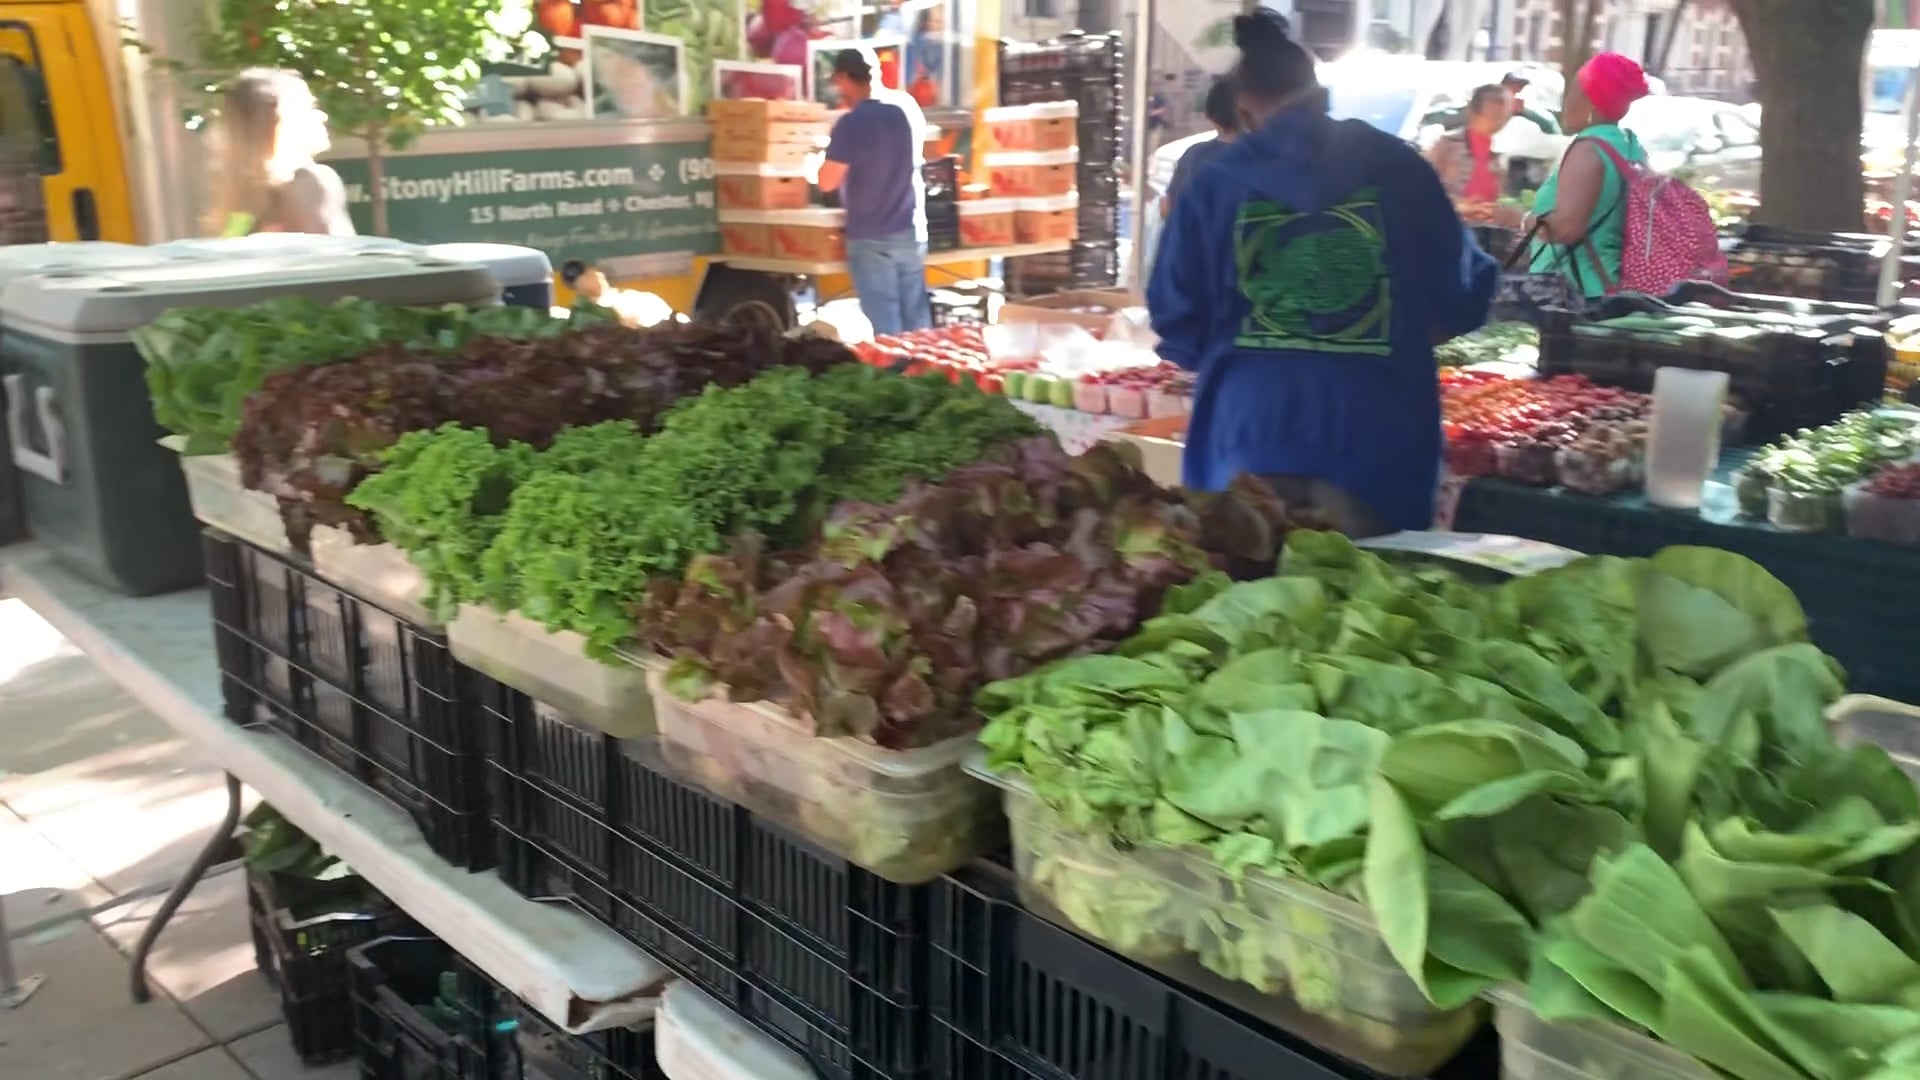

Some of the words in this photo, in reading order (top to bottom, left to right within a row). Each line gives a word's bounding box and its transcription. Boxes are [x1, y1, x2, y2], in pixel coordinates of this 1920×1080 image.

[469, 205, 495, 224] 15
[499, 202, 554, 222] North
[556, 198, 604, 217] Road
